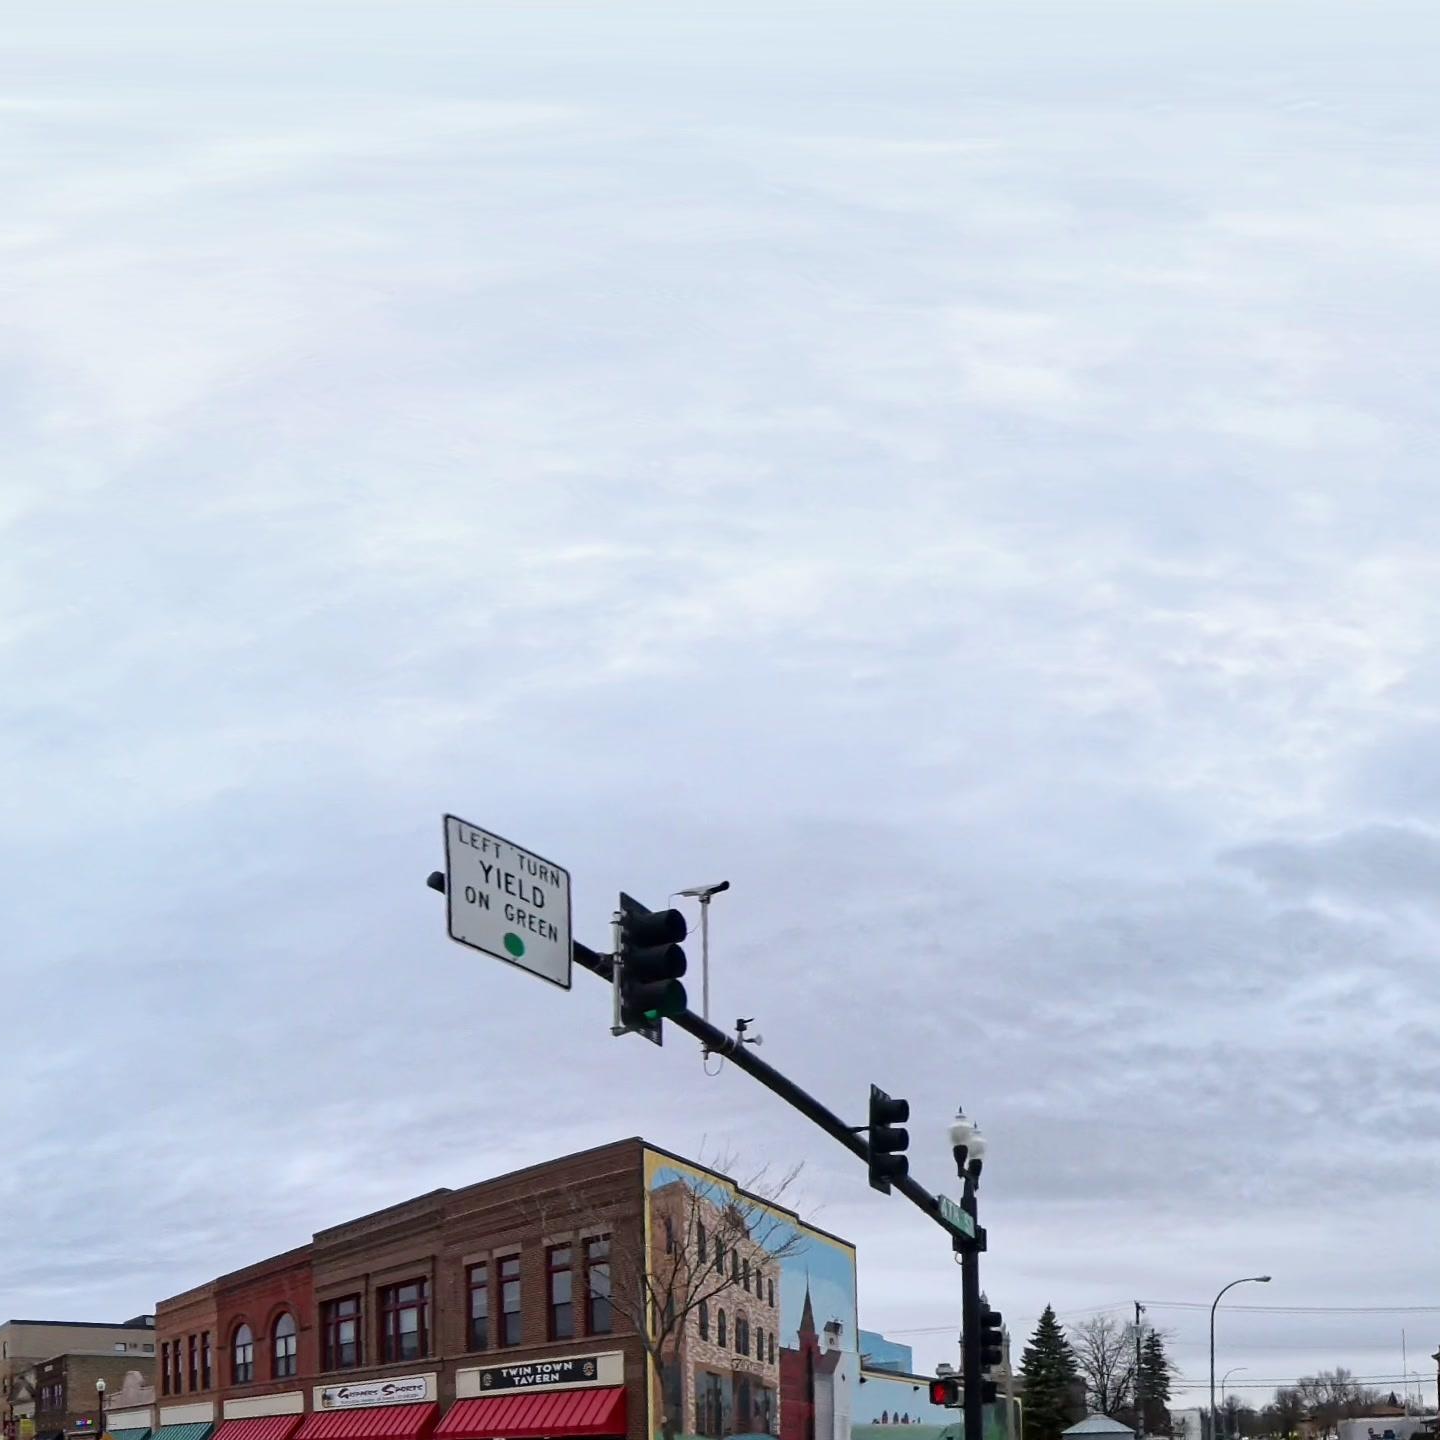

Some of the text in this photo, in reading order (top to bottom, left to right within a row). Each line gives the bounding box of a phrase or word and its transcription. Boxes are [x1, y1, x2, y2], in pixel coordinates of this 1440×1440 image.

[458, 823, 560, 888] LEFT TURN
[479, 860, 545, 908] YIELD
[465, 886, 558, 942] ON GREEN
[501, 1361, 573, 1378] TWIN TOWN
[513, 1373, 560, 1385] TAVERN
